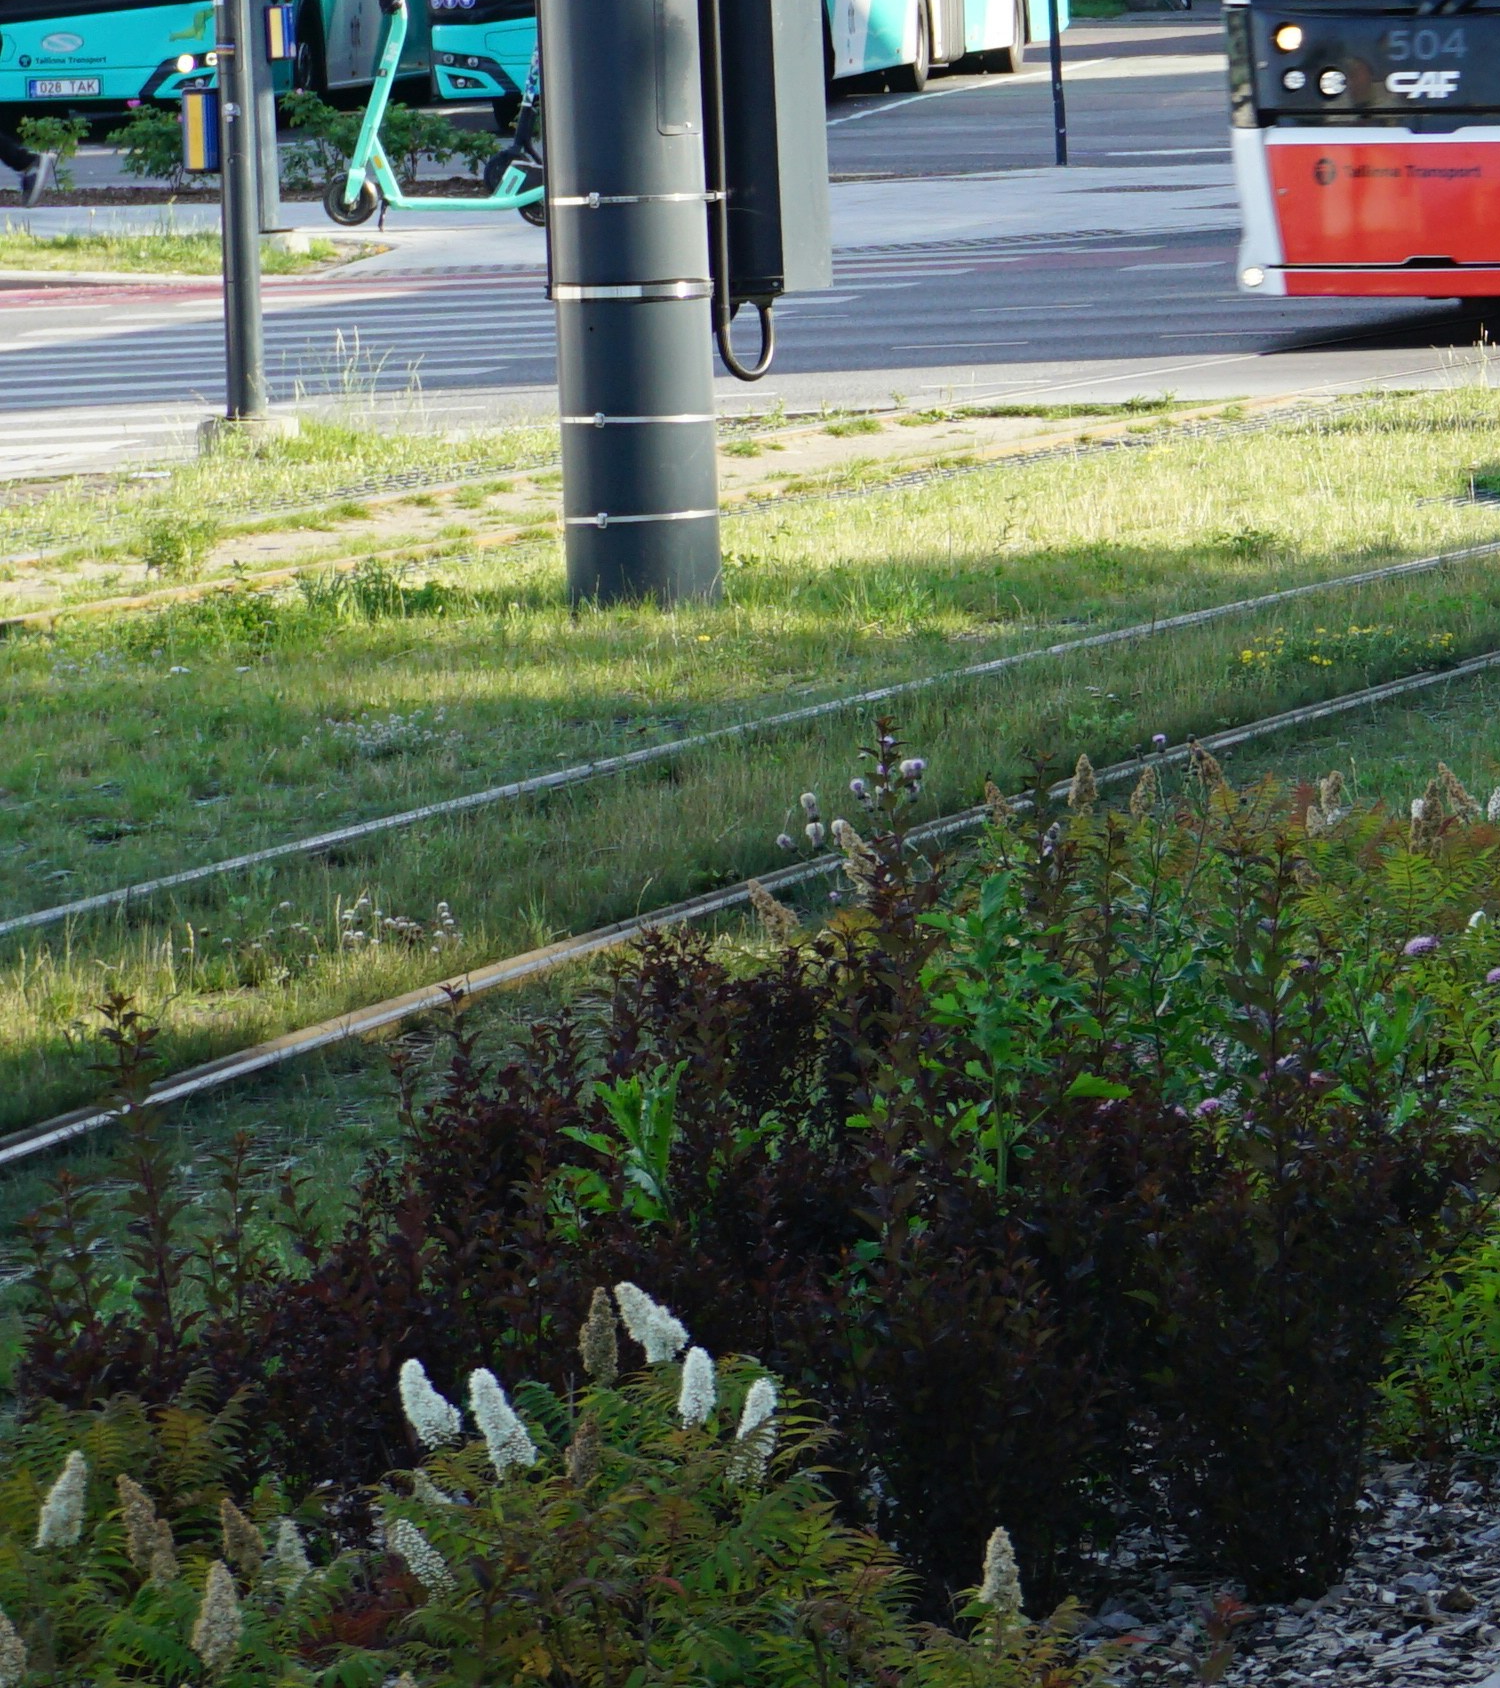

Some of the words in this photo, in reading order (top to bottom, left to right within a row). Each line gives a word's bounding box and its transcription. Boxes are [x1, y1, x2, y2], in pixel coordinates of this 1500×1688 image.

[1387, 27, 1468, 61] 504
[69, 56, 107, 64] Transport
[70, 80, 96, 92] TAK
[1385, 70, 1461, 99] CAF
[1405, 164, 1482, 180] Transport
